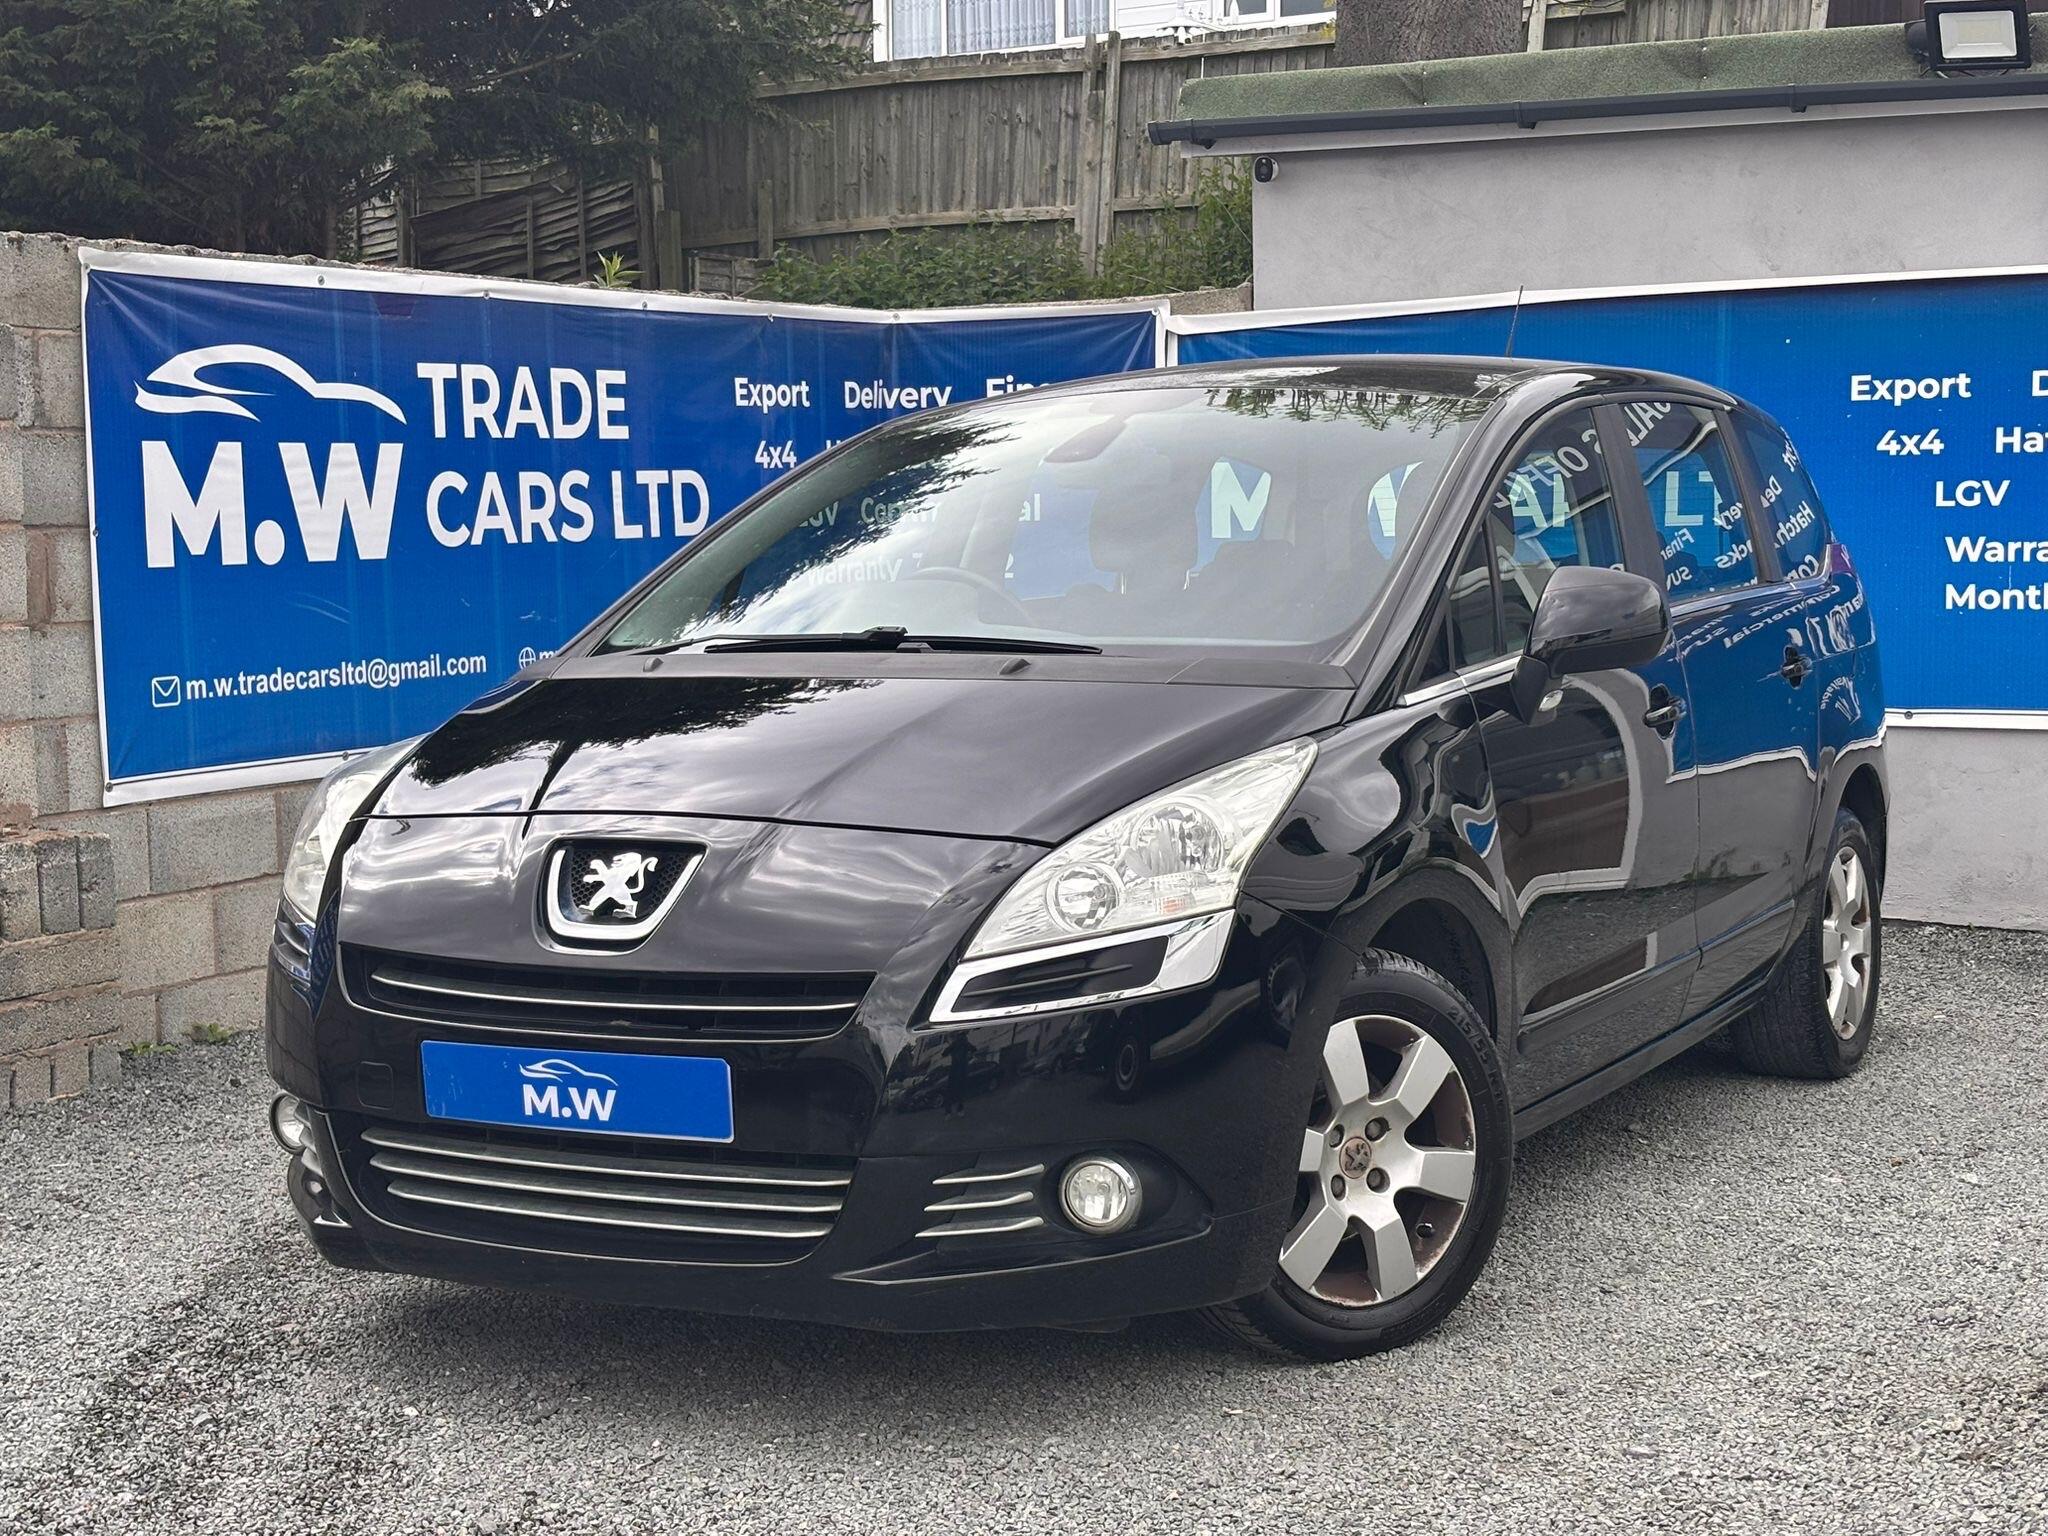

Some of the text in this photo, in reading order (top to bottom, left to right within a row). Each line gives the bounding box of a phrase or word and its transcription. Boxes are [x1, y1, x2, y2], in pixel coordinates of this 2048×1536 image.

[416, 362, 630, 440] TRADE
[734, 377, 811, 414] Export
[844, 379, 953, 409] Delivery
[1850, 373, 1972, 406] Export
[755, 440, 797, 469] 4x4
[1876, 426, 2048, 456] 4x4 Ha
[140, 440, 405, 569] M.W
[426, 468, 710, 548] CARS LTD
[1935, 480, 2011, 507] LGV
[185, 653, 488, 700] m.w.tradecarsltd@gmail.com
[522, 1083, 617, 1122] M.W
